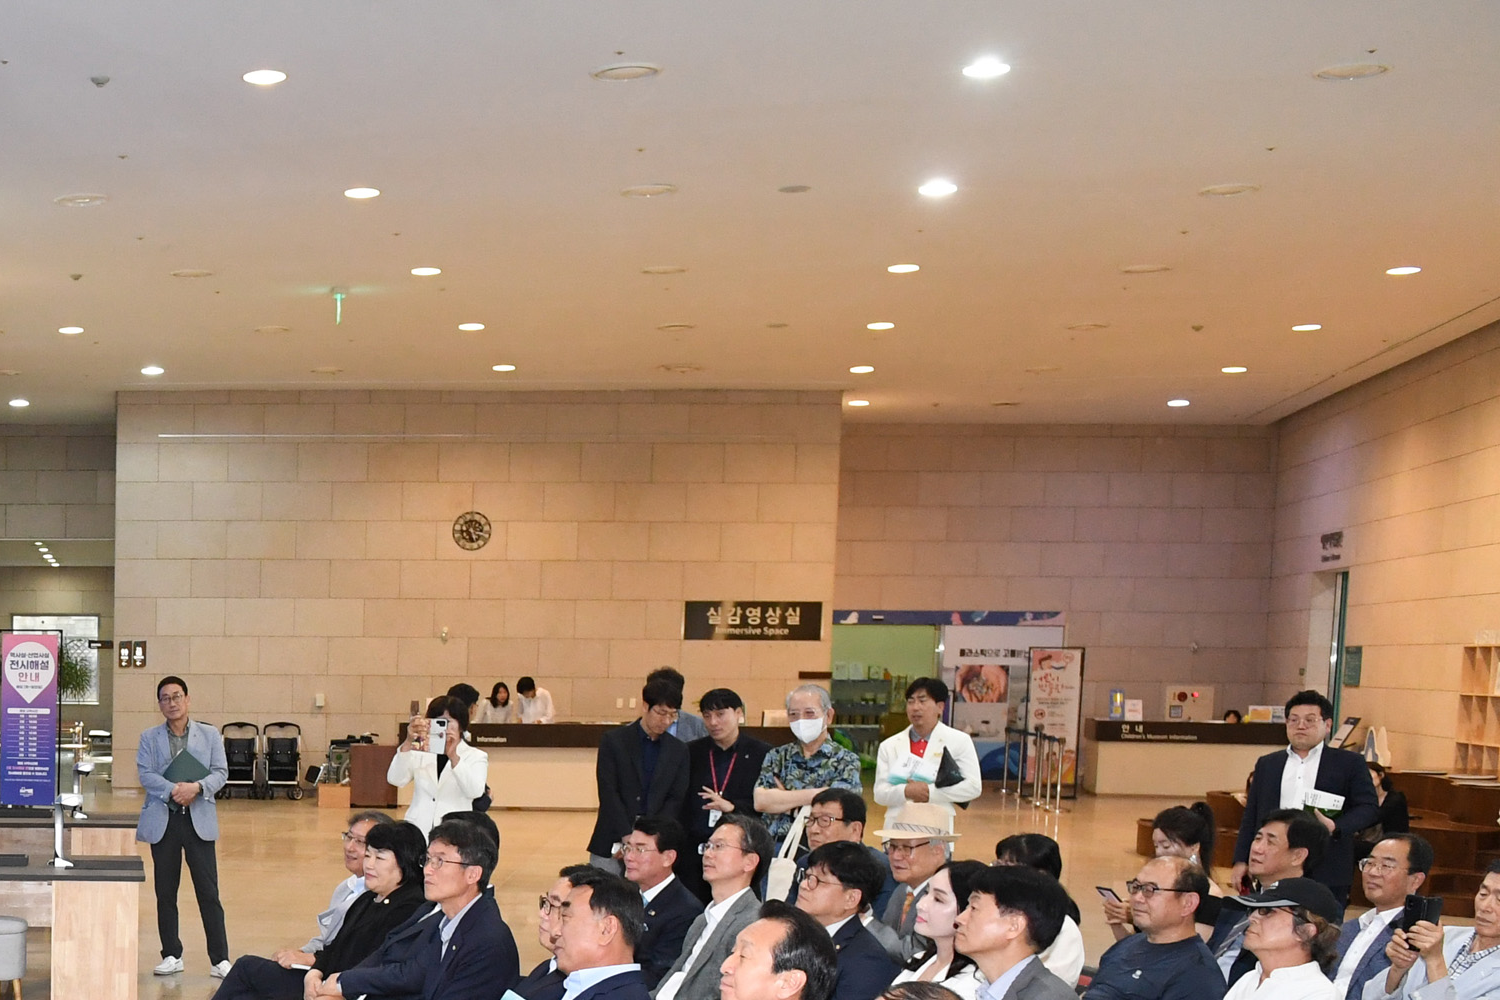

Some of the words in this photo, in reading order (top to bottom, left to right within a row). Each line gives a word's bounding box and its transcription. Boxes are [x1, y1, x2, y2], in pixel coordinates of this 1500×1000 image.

[706, 606, 801, 626] 실감영상실
[715, 626, 762, 635] Immersive
[763, 626, 790, 636] Space
[9, 660, 49, 671] 전시해설
[18, 672, 40, 682] 안내
[1121, 724, 1144, 733] 안내
